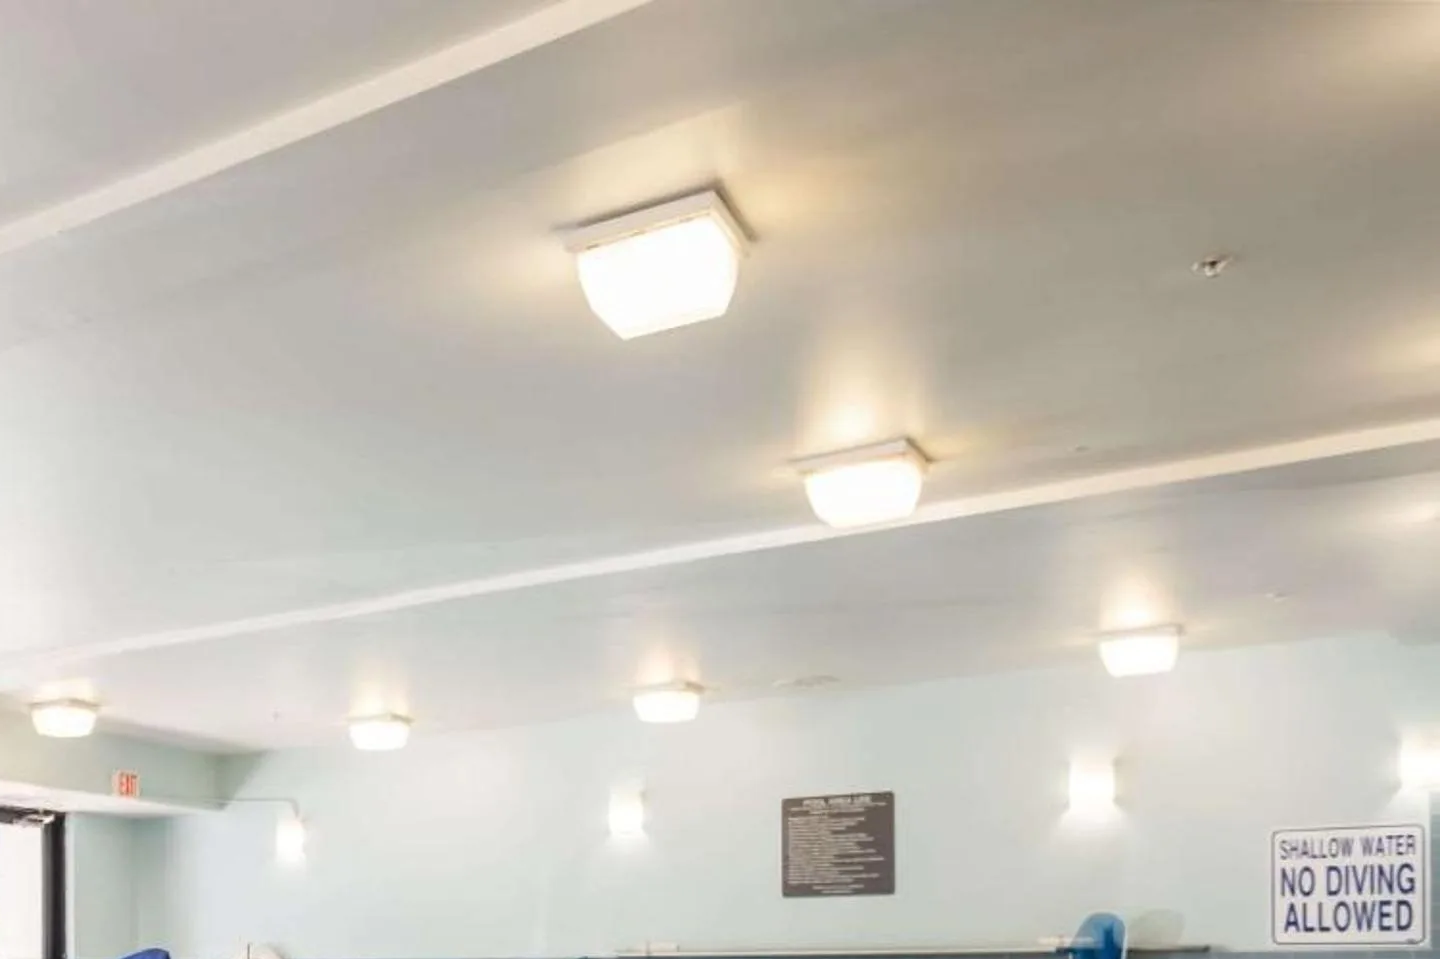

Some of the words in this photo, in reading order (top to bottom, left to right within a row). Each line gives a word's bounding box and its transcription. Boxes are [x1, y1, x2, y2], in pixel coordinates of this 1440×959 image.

[1280, 837, 1354, 860] SHALLOW
[1360, 835, 1416, 857] WATER
[1280, 866, 1315, 897] NO
[1326, 863, 1416, 896] DIVING
[1284, 900, 1414, 933] ALLOWED
